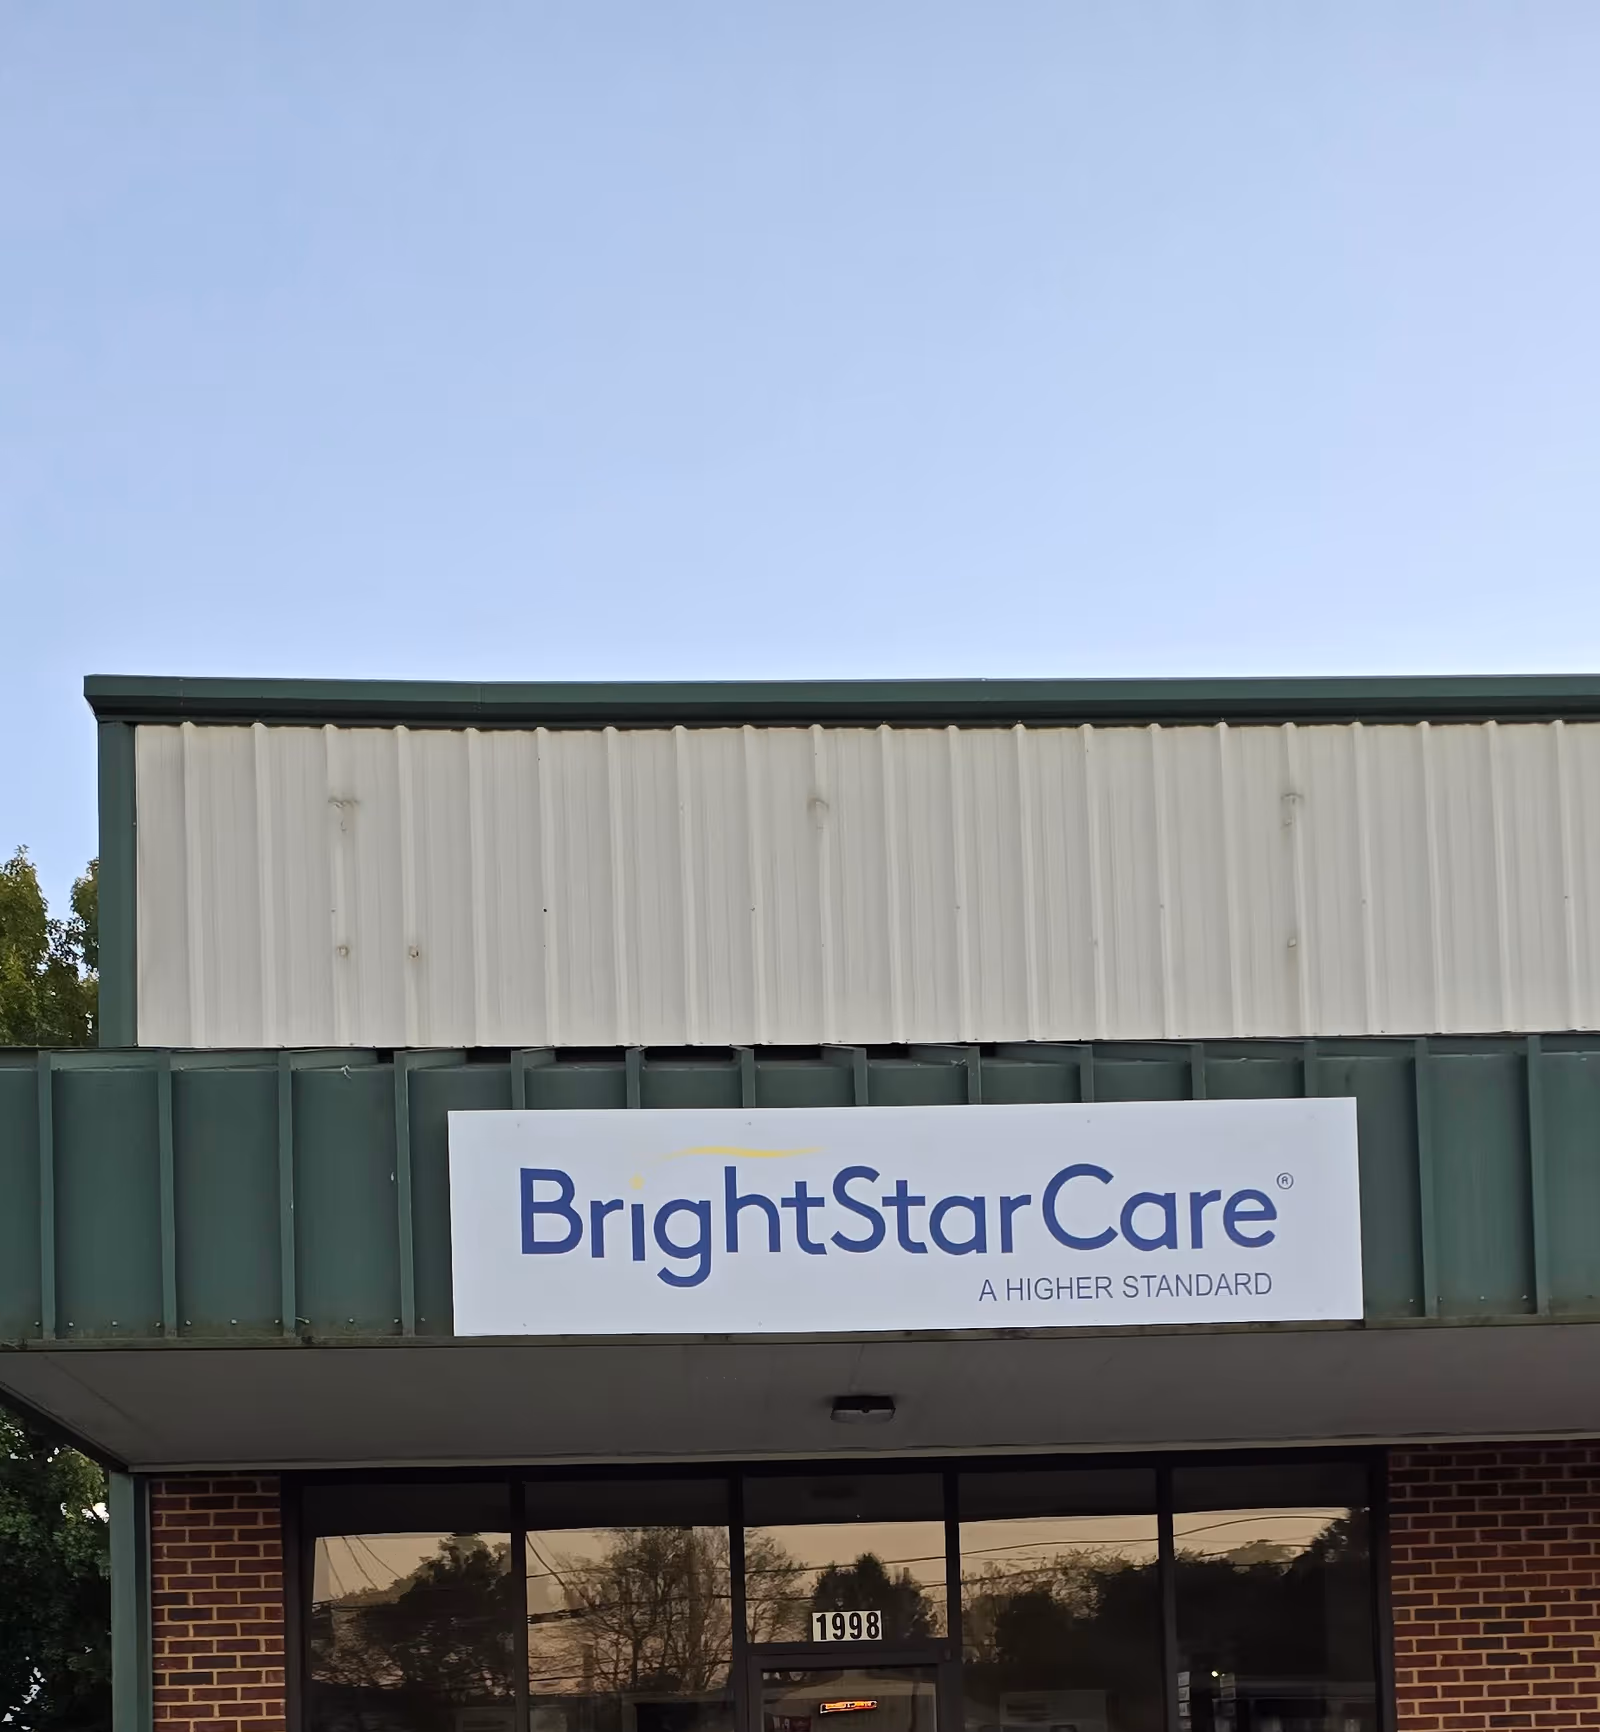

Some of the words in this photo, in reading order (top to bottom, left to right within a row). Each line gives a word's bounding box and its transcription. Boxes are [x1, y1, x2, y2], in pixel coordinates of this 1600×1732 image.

[978, 1279, 998, 1302] A
[1006, 1276, 1114, 1302] HIGHER
[1122, 1273, 1272, 1300] STANDARD
[815, 1611, 880, 1640] 1998
